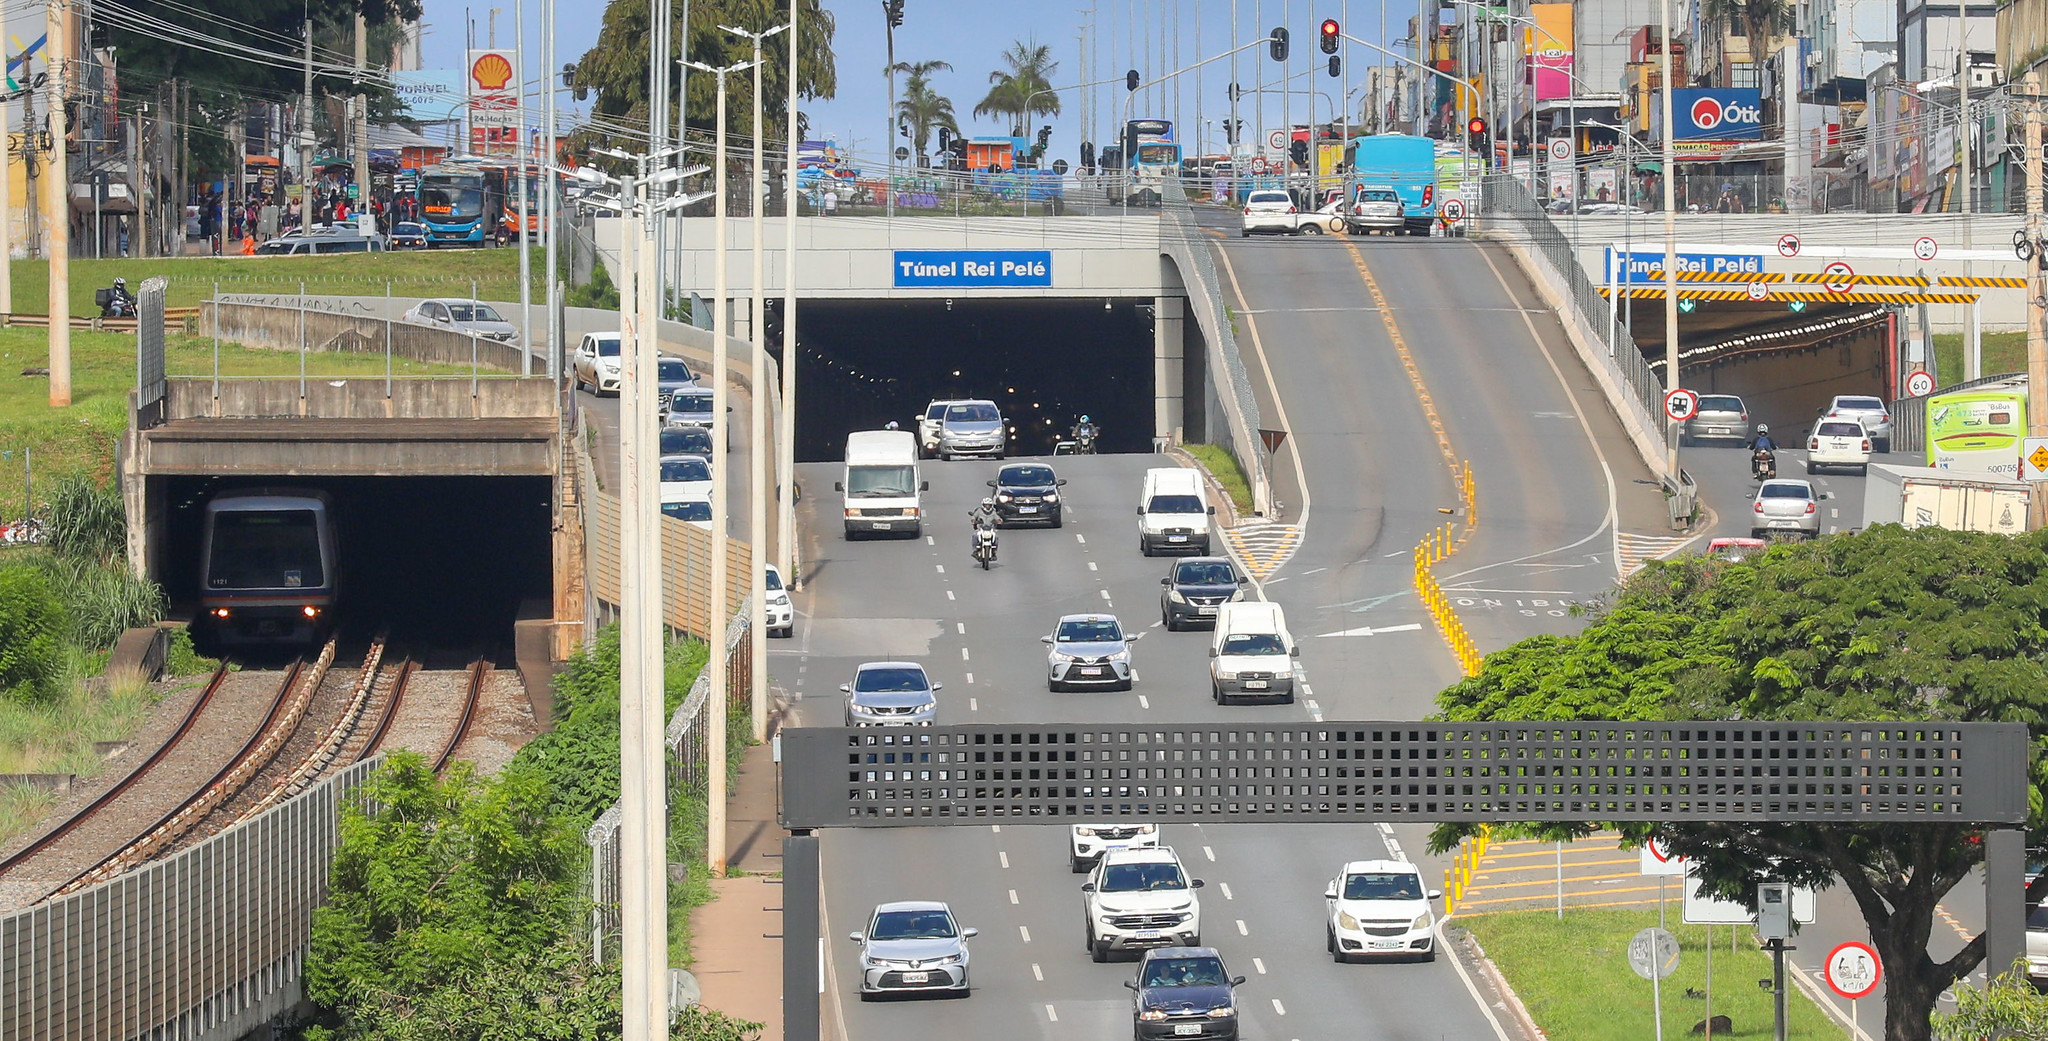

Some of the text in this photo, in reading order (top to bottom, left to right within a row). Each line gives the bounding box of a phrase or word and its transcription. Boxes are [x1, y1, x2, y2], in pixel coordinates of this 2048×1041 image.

[474, 115, 485, 123] 24
[1254, 161, 1263, 169] 30
[900, 261, 1046, 277] Túnel Rei Pelé
[1617, 257, 1758, 274] Túnel Rei Pelé
[1913, 380, 1928, 390] 60
[1988, 464, 2017, 474] 500755
